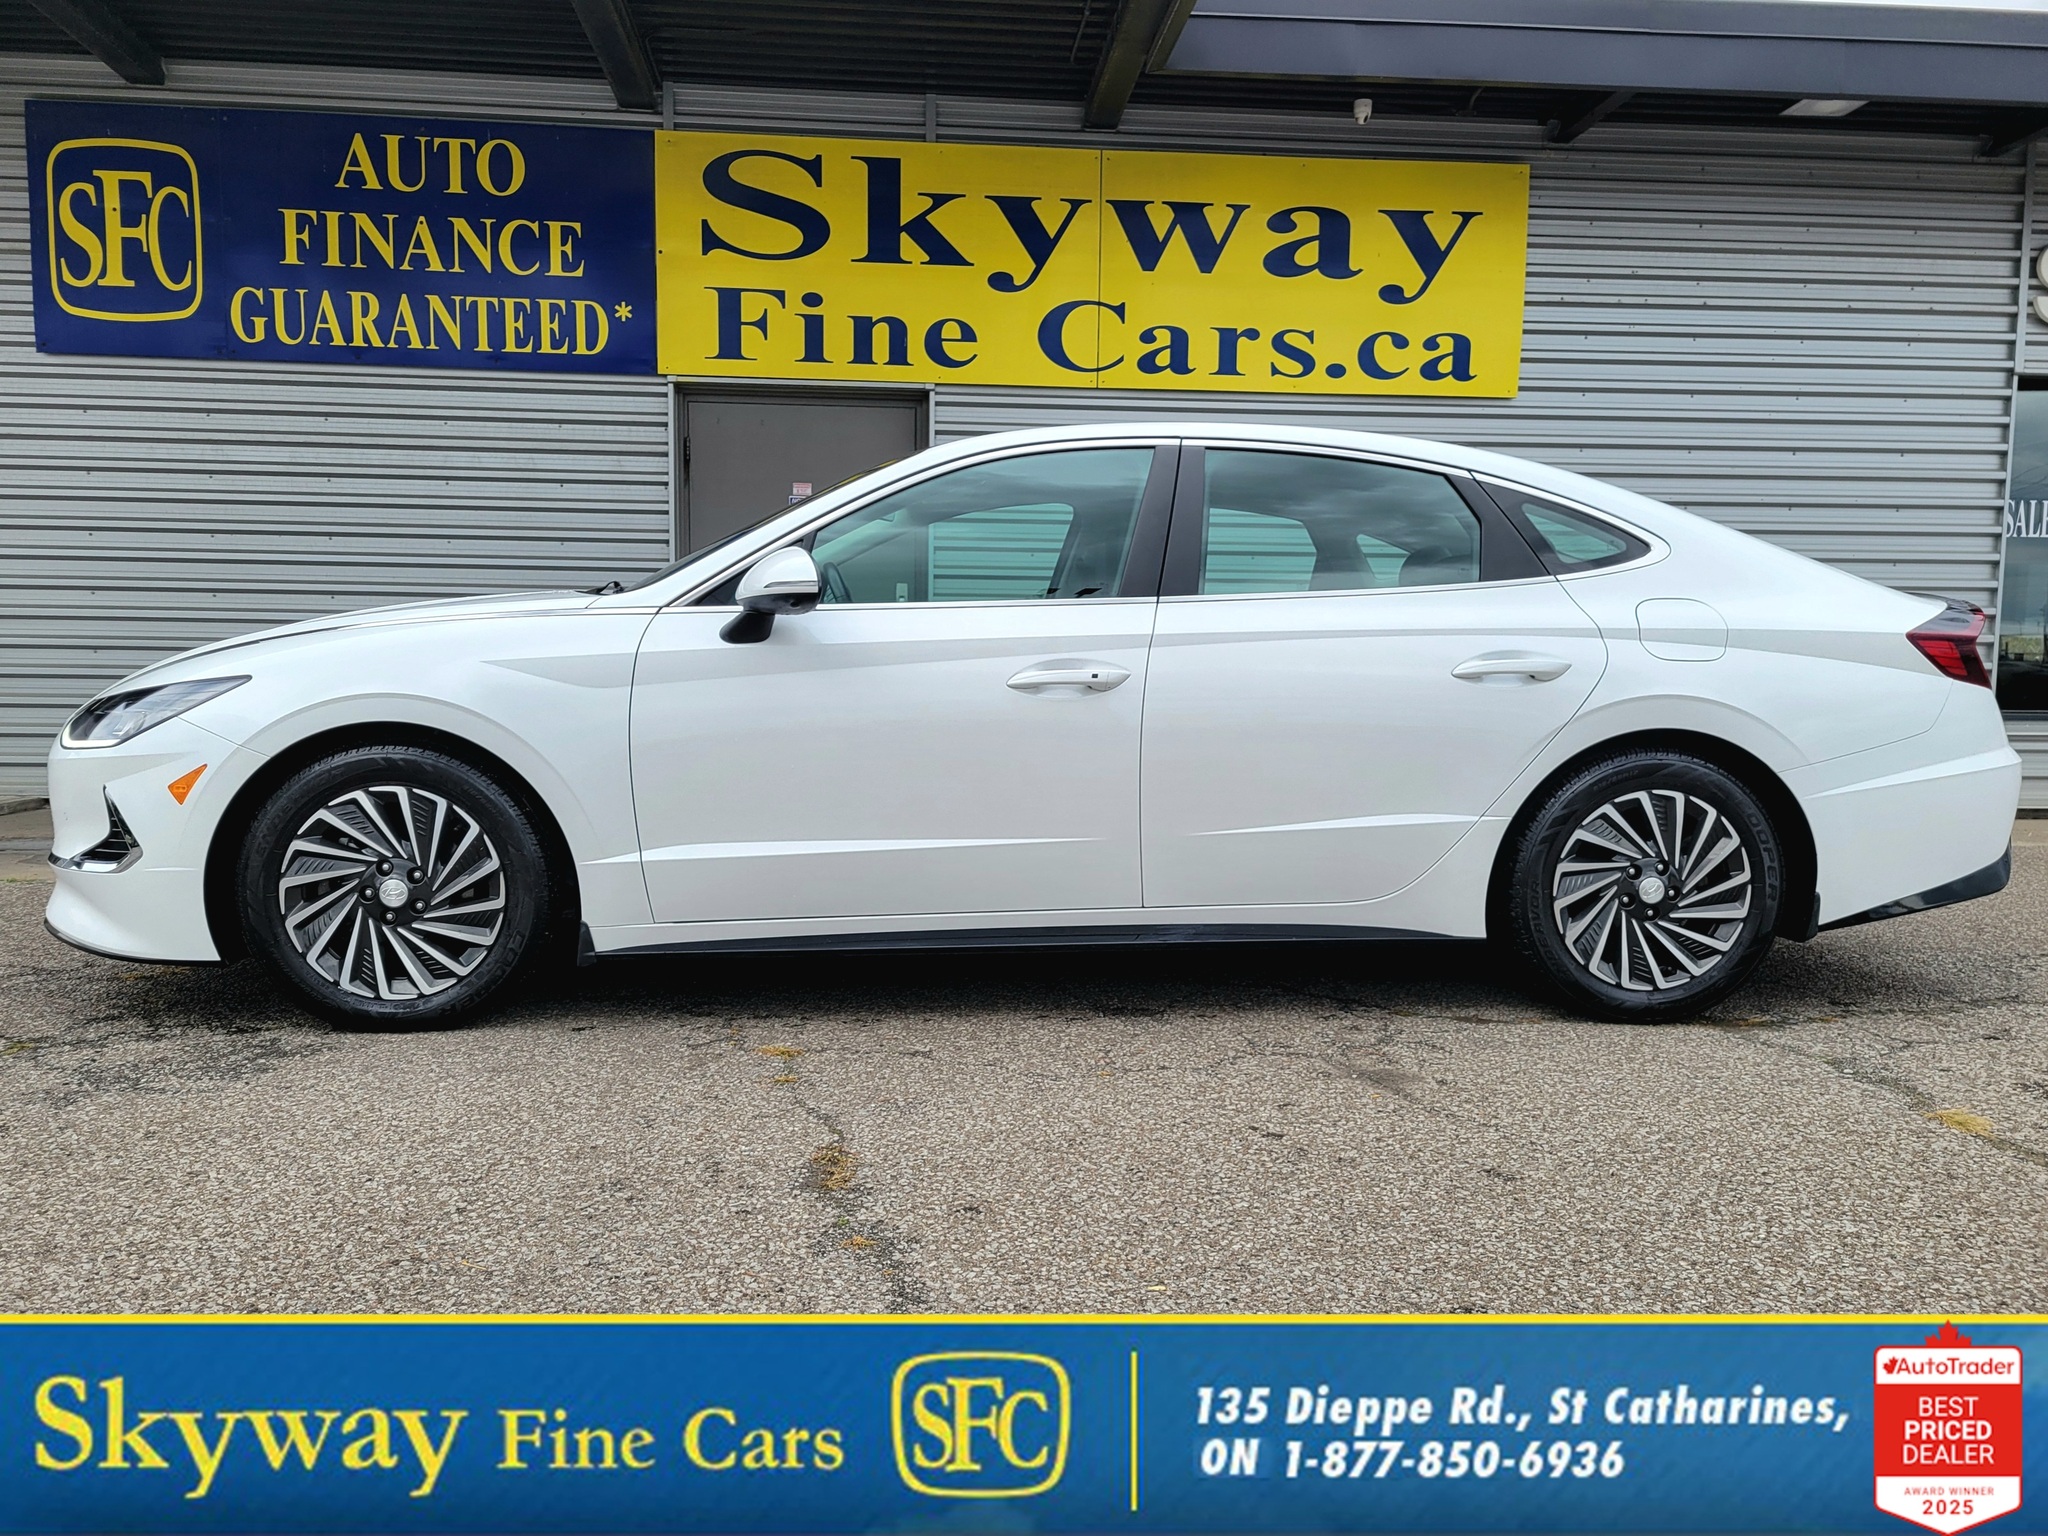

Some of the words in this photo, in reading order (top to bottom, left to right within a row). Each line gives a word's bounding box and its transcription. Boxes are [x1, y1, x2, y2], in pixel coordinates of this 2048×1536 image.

[336, 133, 526, 197] AUTO
[57, 168, 193, 292] SFC
[280, 208, 585, 278] FINANCE
[701, 149, 1484, 305] Skyway
[703, 285, 978, 369] Fine
[1037, 299, 1478, 382] Cars.ca
